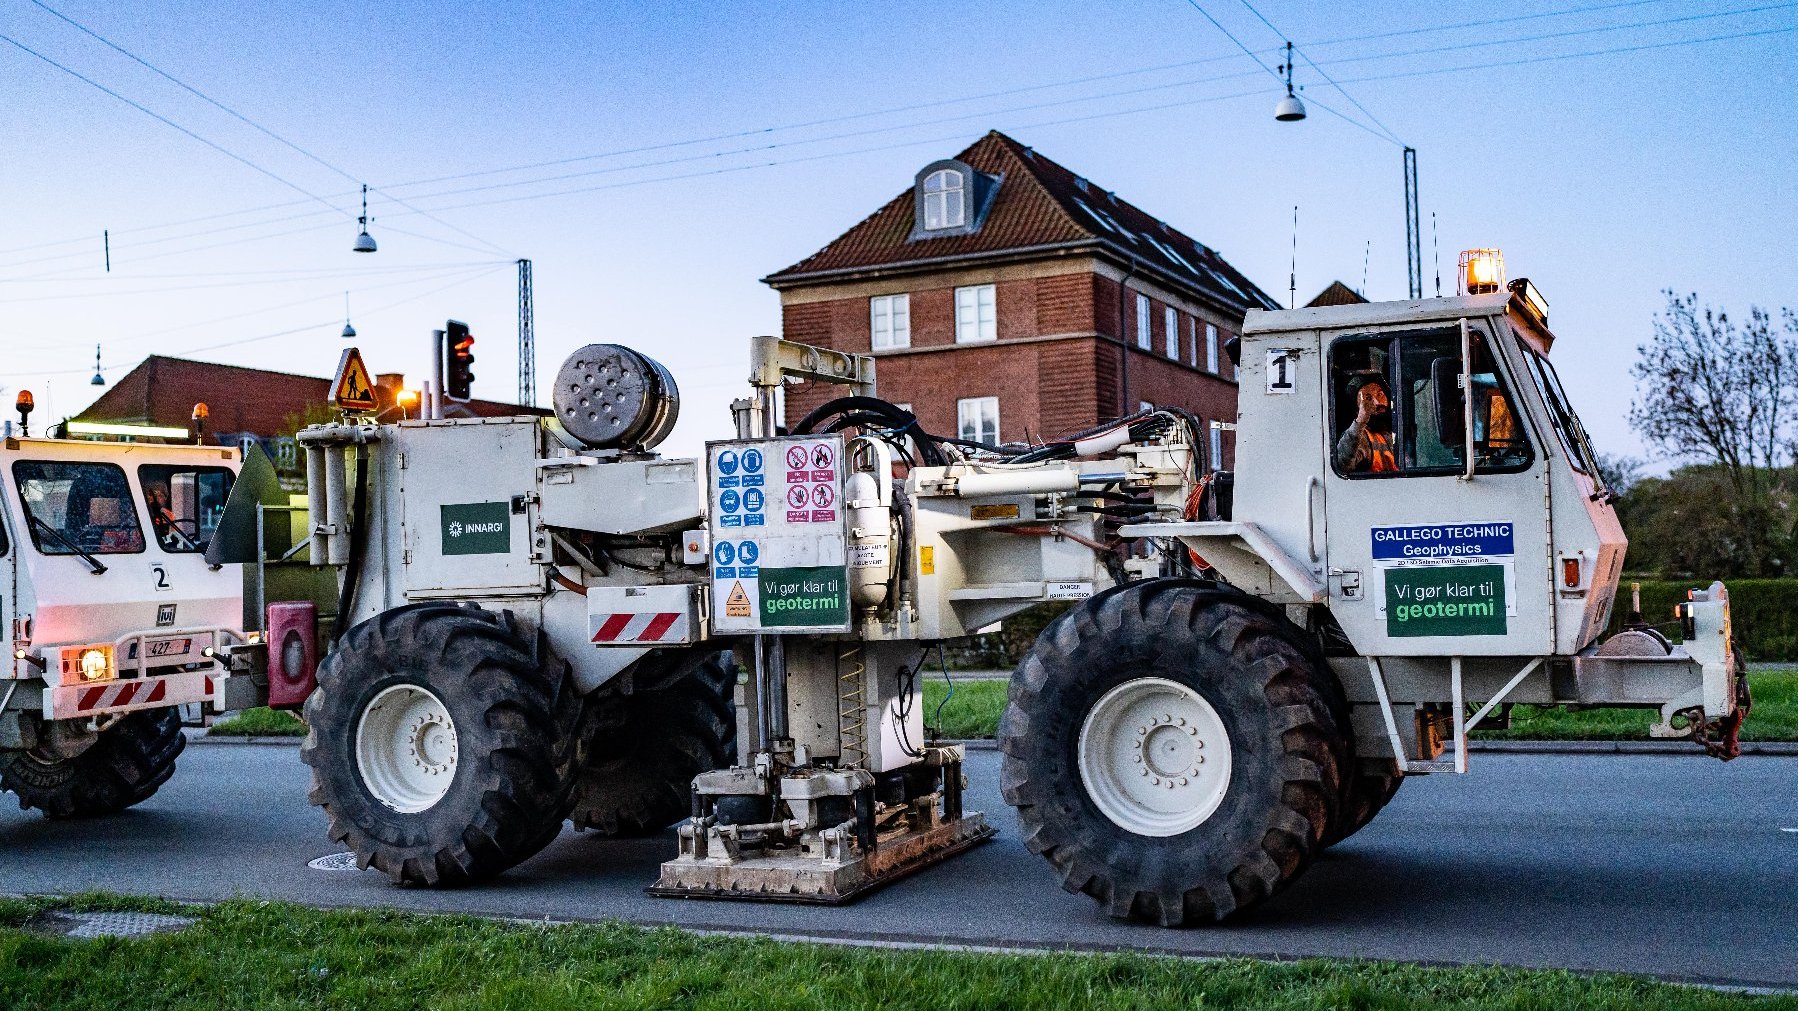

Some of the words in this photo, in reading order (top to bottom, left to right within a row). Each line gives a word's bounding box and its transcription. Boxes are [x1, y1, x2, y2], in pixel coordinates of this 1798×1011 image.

[1272, 355, 1292, 388] 1
[465, 522, 503, 534] INNARGI
[1374, 528, 1442, 541] GALLEGO
[1445, 525, 1510, 538] TECHNIC
[1403, 543, 1482, 557] Geophysics
[153, 567, 170, 588] 2
[765, 582, 777, 594] Vi
[780, 583, 800, 596] gør
[803, 581, 824, 592] klar
[828, 580, 838, 592] til
[1394, 584, 1410, 598] Vi
[1415, 586, 1442, 601] gør
[1446, 583, 1475, 596] klar
[1479, 582, 1494, 596] til
[766, 594, 839, 614] geotermi
[1396, 598, 1494, 622] geotermi
